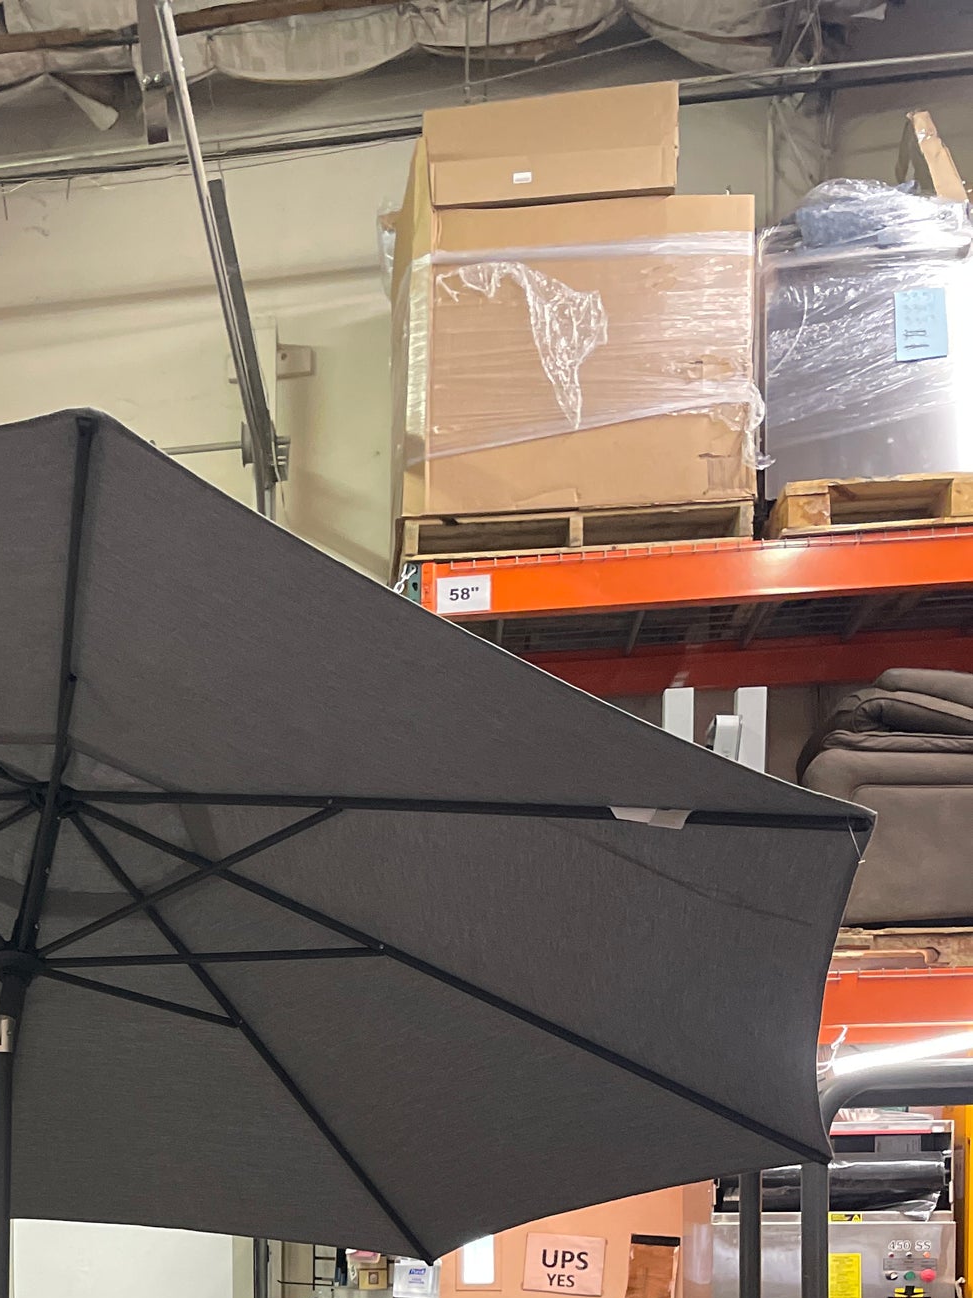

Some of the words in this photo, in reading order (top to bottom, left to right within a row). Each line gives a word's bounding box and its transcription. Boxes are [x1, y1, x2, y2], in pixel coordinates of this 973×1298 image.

[449, 587, 479, 601] 58"
[888, 1240, 912, 1251] 450
[915, 1240, 932, 1251] SS
[541, 1249, 589, 1271] UPS
[547, 1273, 575, 1288] YES
